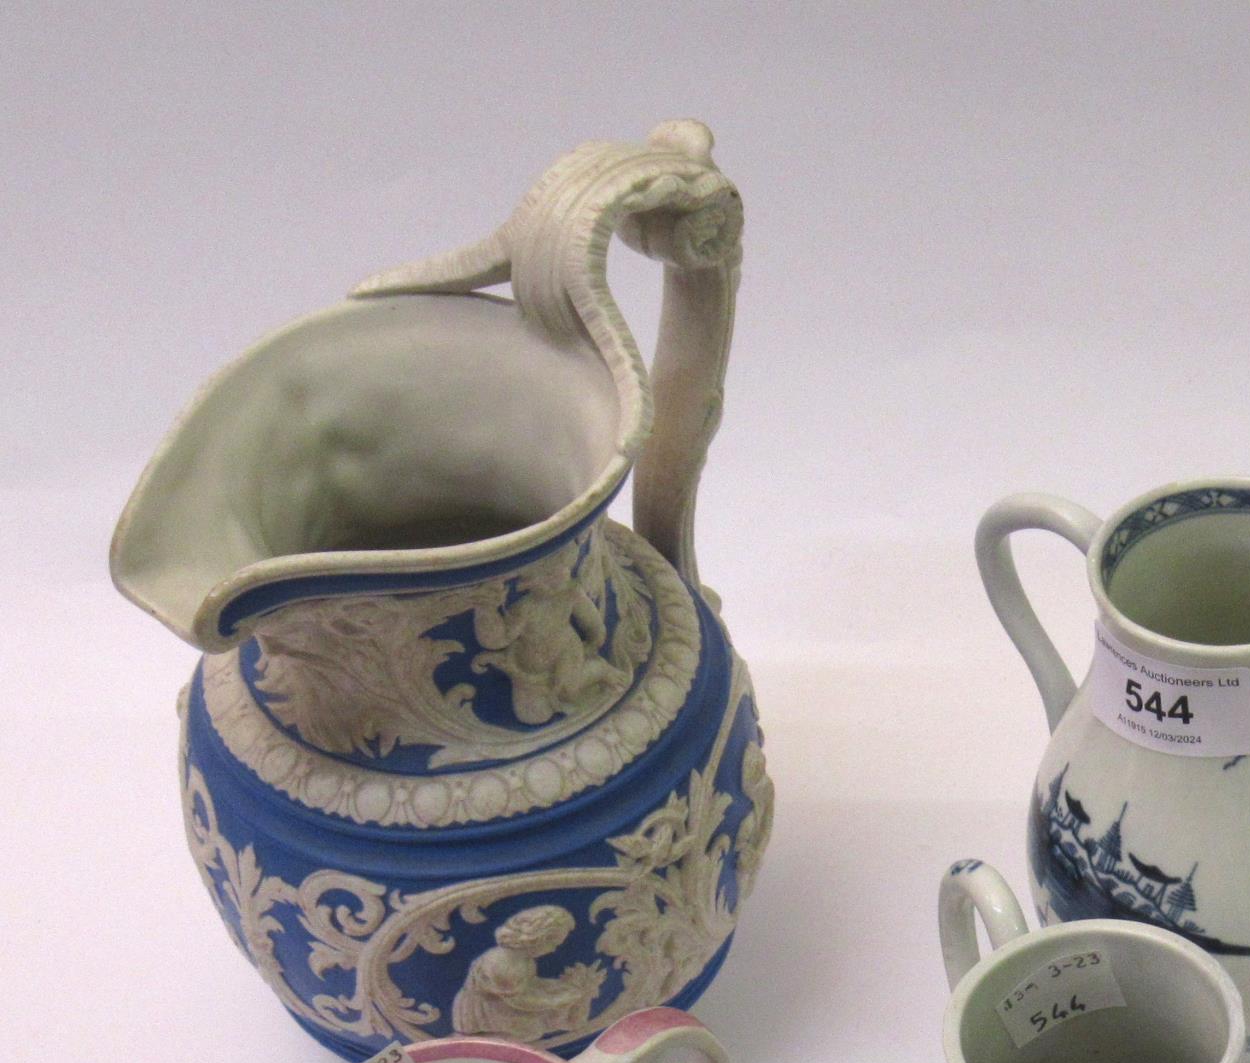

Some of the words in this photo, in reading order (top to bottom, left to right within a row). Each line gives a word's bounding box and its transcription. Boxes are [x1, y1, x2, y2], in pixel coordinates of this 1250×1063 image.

[1140, 665, 1213, 688] Auctioneers
[1218, 677, 1240, 687] Ltd
[1125, 678, 1194, 725] 544
[1149, 728, 1202, 744] 12/03/2024
[1048, 952, 1101, 978] 3-23
[1030, 994, 1087, 1032] 544
